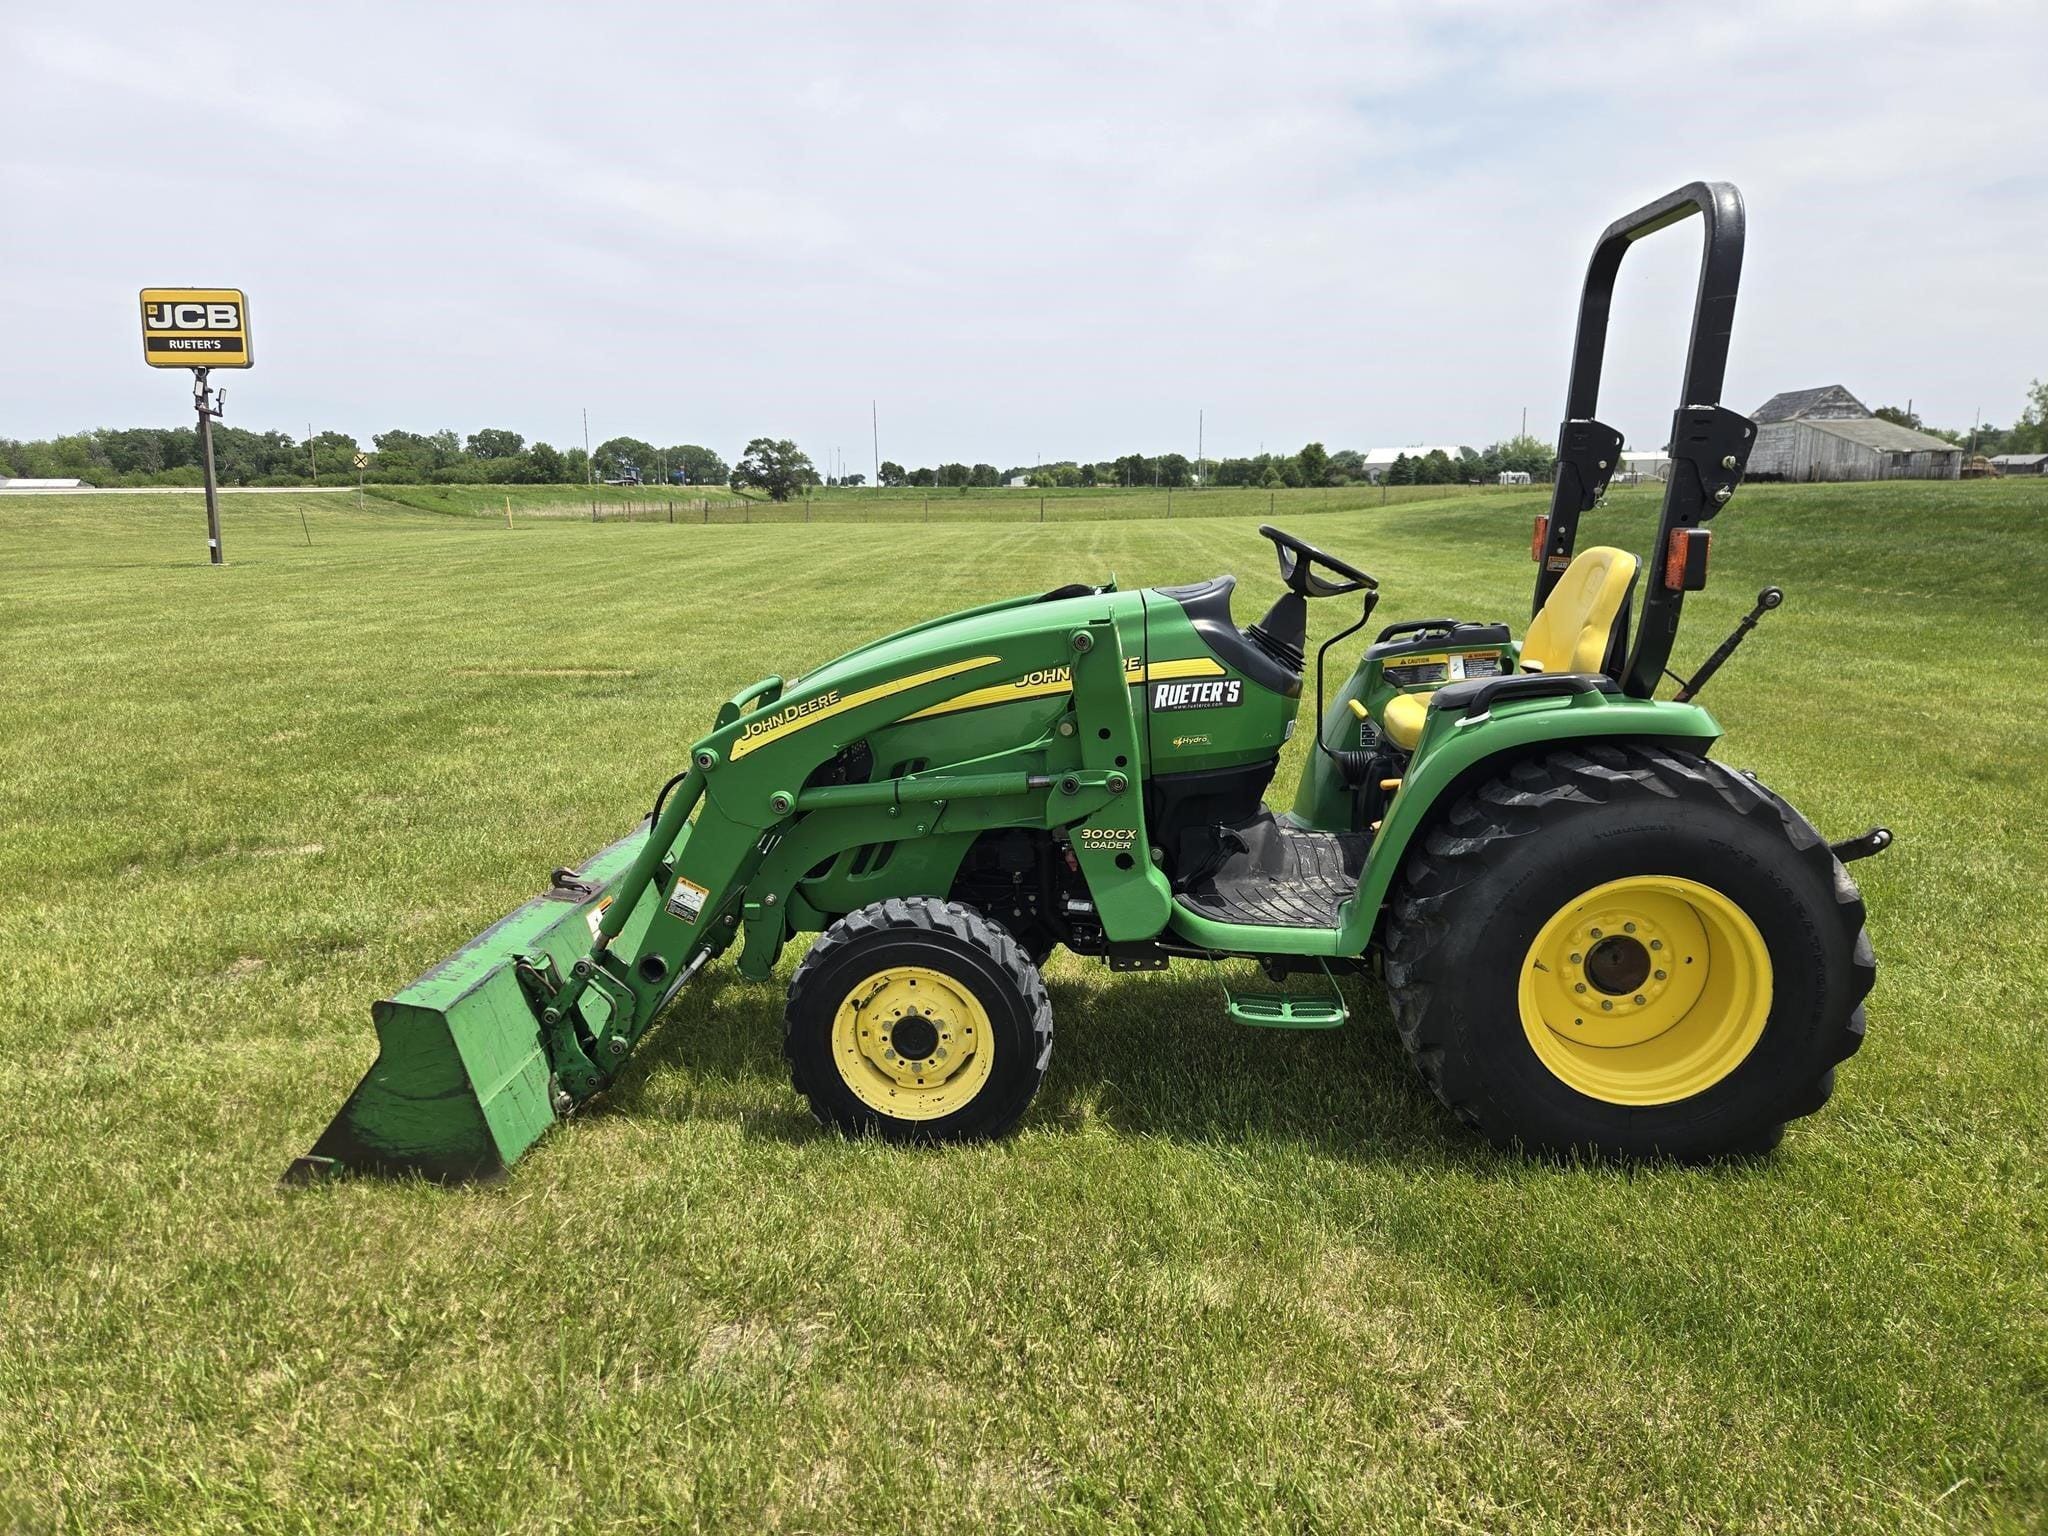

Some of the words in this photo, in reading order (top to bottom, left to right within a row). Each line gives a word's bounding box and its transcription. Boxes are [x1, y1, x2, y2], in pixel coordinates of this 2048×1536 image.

[148, 304, 239, 329] JCB
[169, 340, 221, 350] RUETER'S
[1407, 657, 1430, 665] CAUTION
[1015, 666, 1071, 687] JOHN
[1154, 680, 1241, 709] RUETER'S
[741, 713, 785, 740] JOHN
[784, 690, 840, 721] DEERE
[1081, 829, 1137, 840] 300CX
[1084, 841, 1132, 849] LOADER
